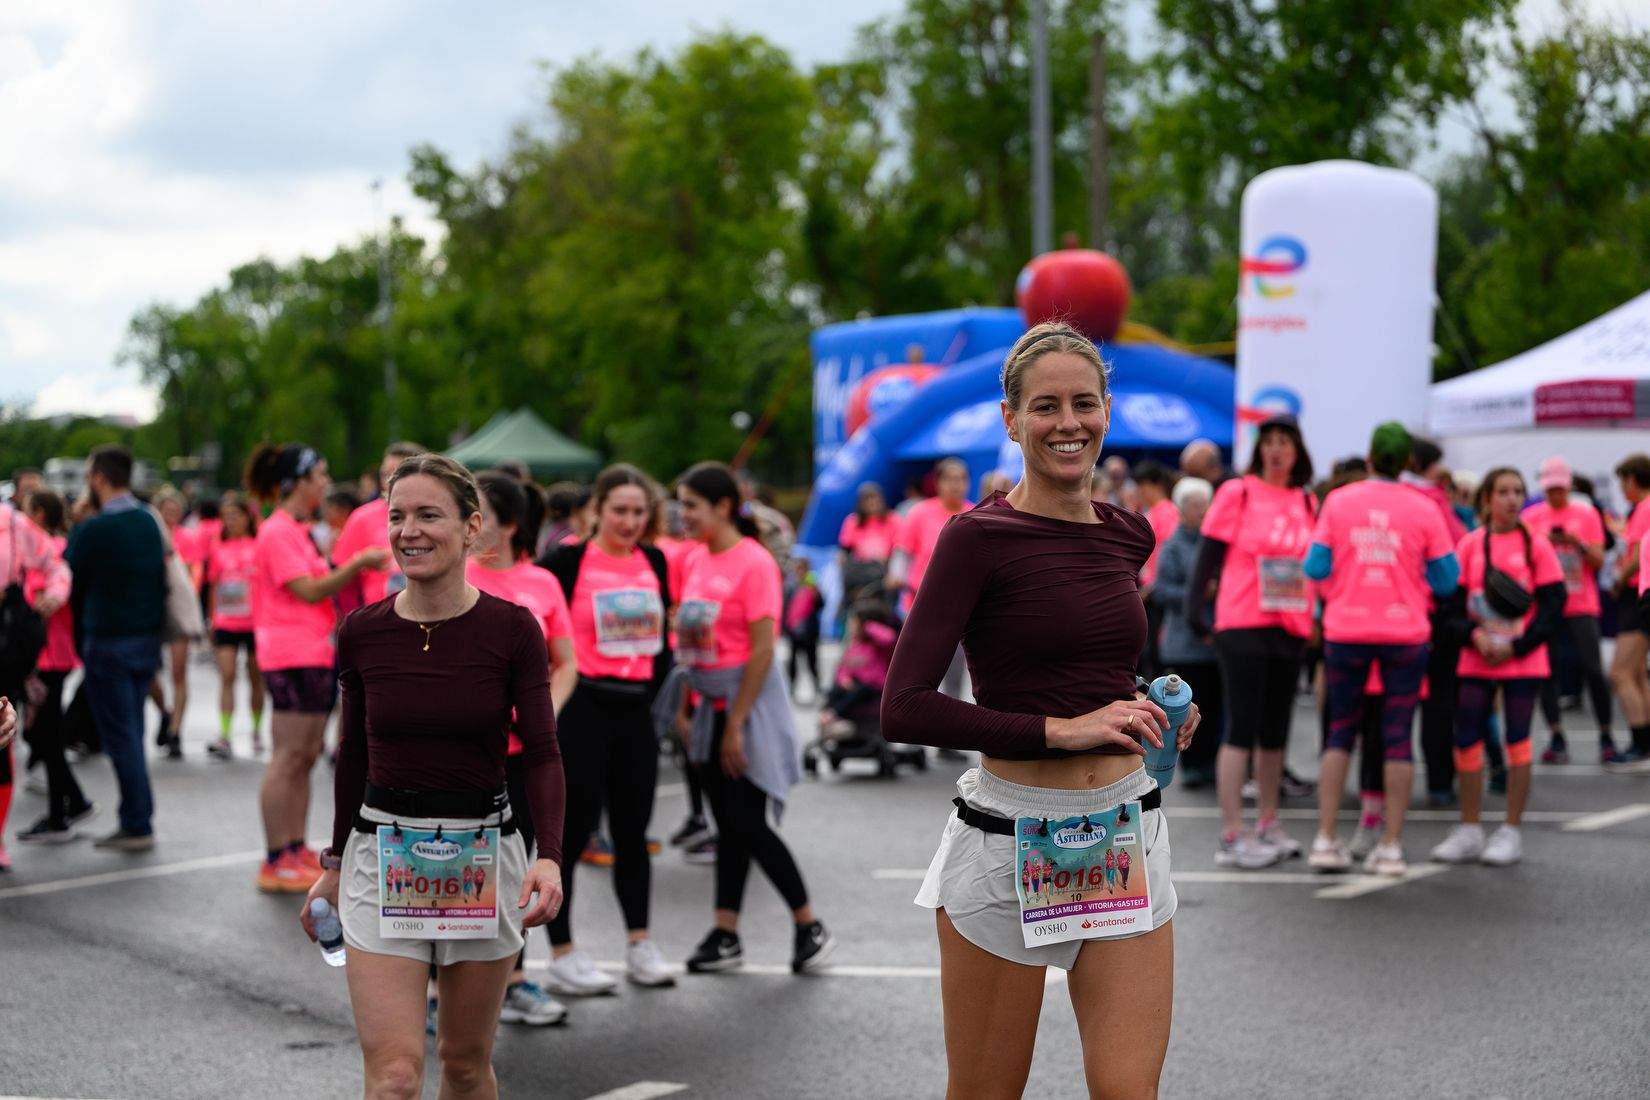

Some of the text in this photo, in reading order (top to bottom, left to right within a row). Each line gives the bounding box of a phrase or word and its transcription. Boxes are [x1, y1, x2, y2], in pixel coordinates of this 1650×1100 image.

[1056, 831, 1104, 845] ASTURIANA
[414, 843, 460, 856] ASTURIANA
[1054, 865, 1103, 889] 016
[414, 876, 460, 896] 016
[1070, 893, 1082, 902] 10
[384, 908, 407, 916] CARRERA
[407, 908, 415, 916] DE
[415, 908, 421, 916] LA
[421, 908, 440, 916] MUJER
[1025, 909, 1048, 920] CARRERA
[1055, 907, 1062, 915] LA
[1062, 904, 1083, 914] MUJER
[392, 921, 424, 931] OYSHO
[447, 923, 484, 931] Santander
[1092, 916, 1136, 928] Santander
[1034, 921, 1068, 937] OYSHO
